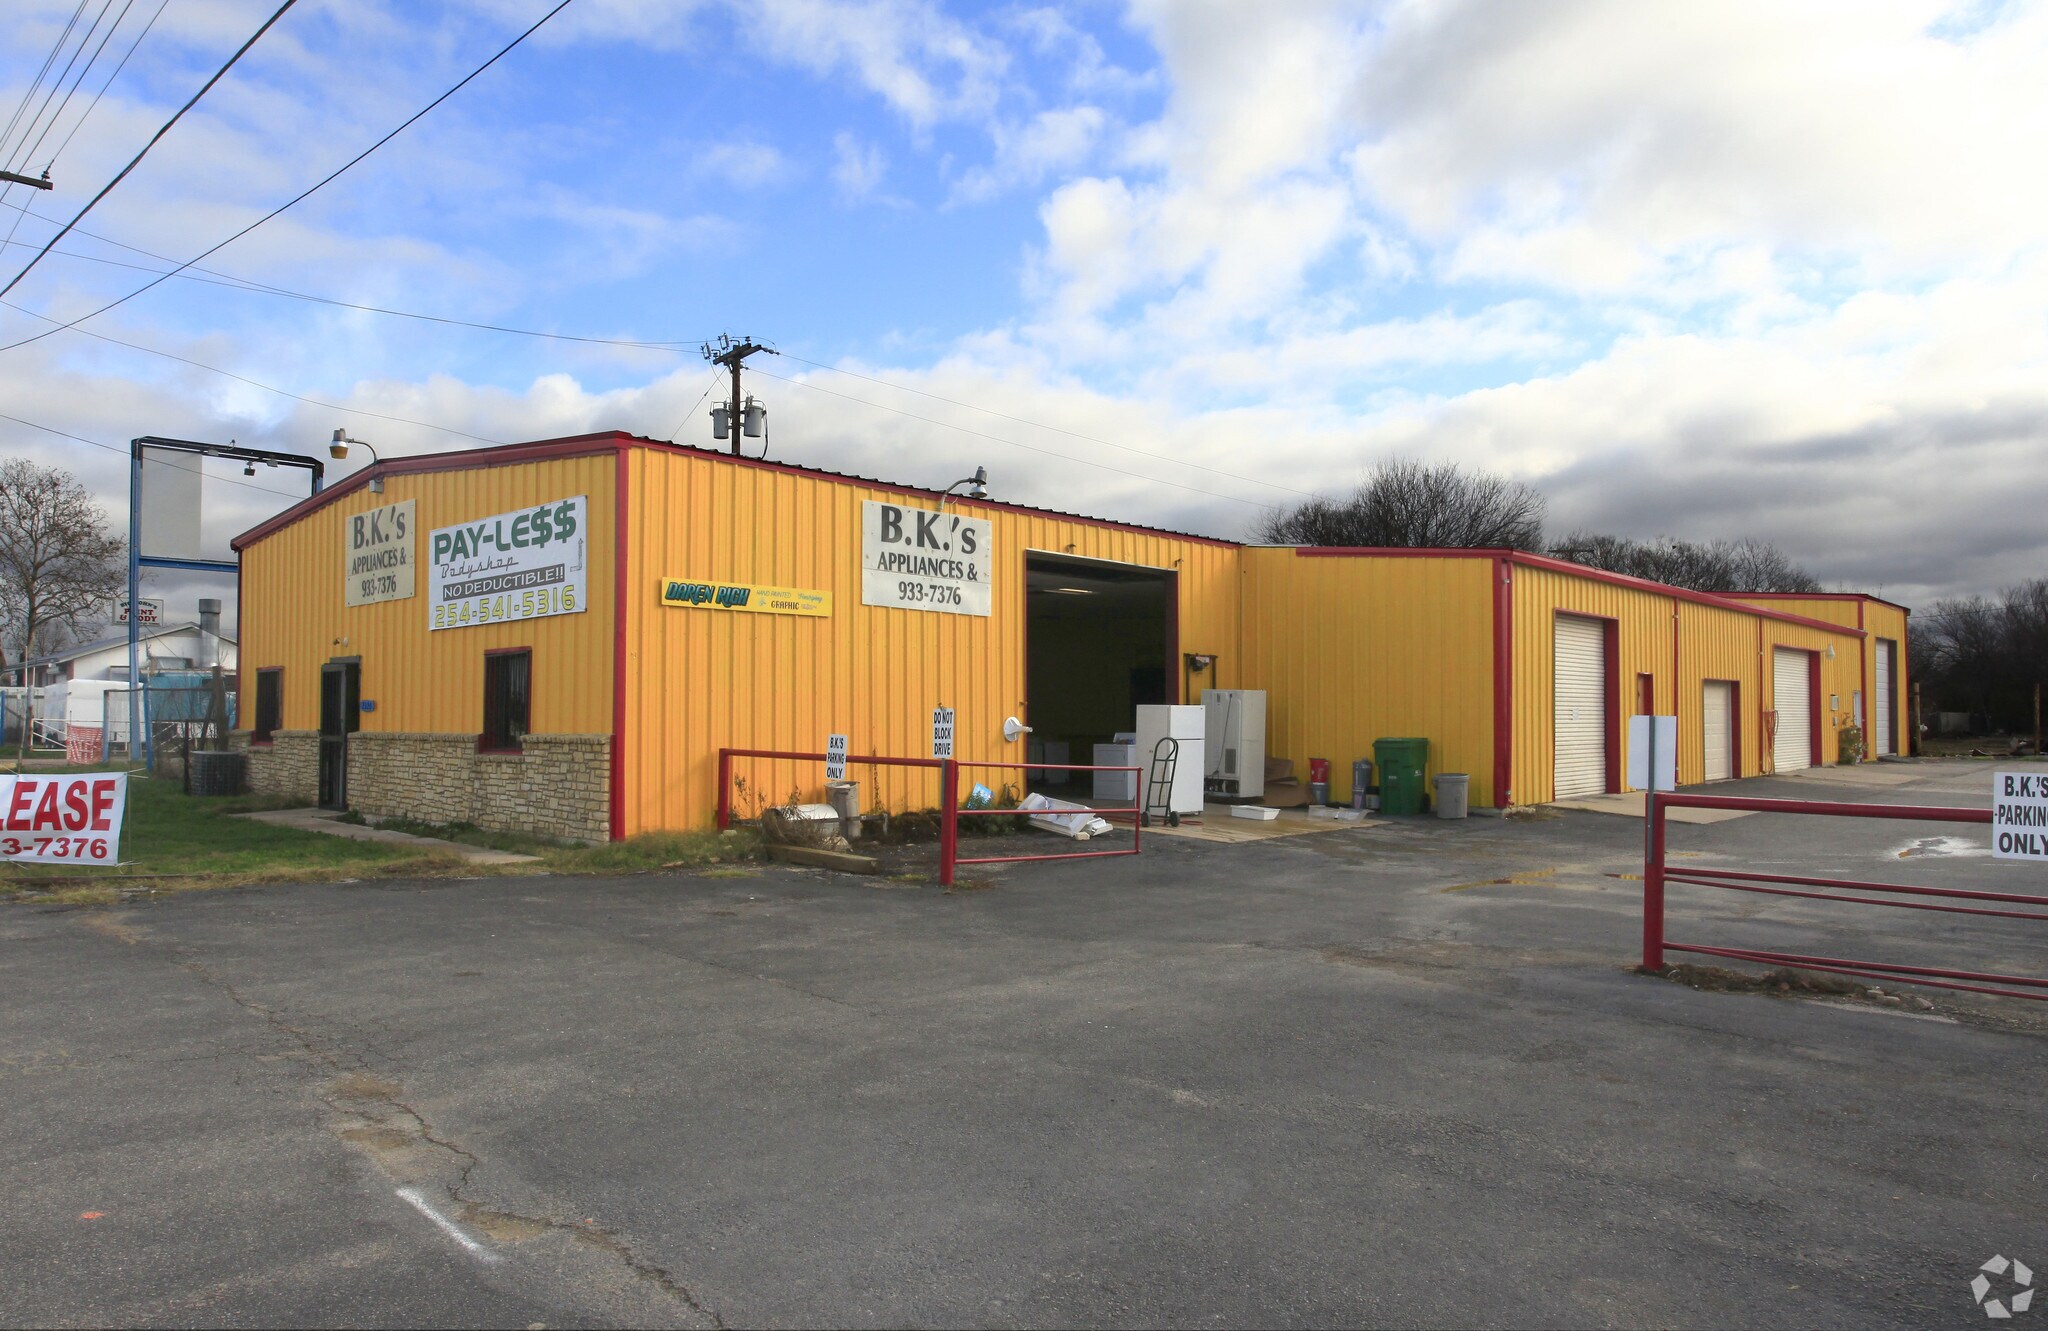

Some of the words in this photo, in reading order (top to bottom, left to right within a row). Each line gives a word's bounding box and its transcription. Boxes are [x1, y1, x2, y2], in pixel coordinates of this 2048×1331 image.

[352, 551, 398, 575] APPLIANCES
[399, 546, 407, 566] &
[441, 555, 519, 578] Bodyshop
[877, 551, 964, 580] APPLIANCES
[966, 563, 979, 582] &
[361, 575, 397, 598] 933-7376
[443, 585, 462, 599] NO
[464, 566, 565, 596] DEDUCTIBLE!!
[898, 580, 962, 606] 933-7376
[138, 601, 157, 609] OHN'S
[434, 585, 576, 627] 254-541-5316
[665, 582, 715, 606] DAREN
[715, 586, 751, 608] RICH
[933, 712, 941, 724] DO
[942, 711, 953, 724] NOT
[830, 737, 844, 750] B.K.'S
[934, 727, 952, 740] BLOCK
[827, 752, 845, 765] PARKING
[934, 742, 951, 756] DRIVE
[826, 767, 843, 779] ONLY
[0, 780, 116, 831] EASE
[1998, 804, 2048, 827] PARKIN
[1998, 832, 2048, 856] ONLY
